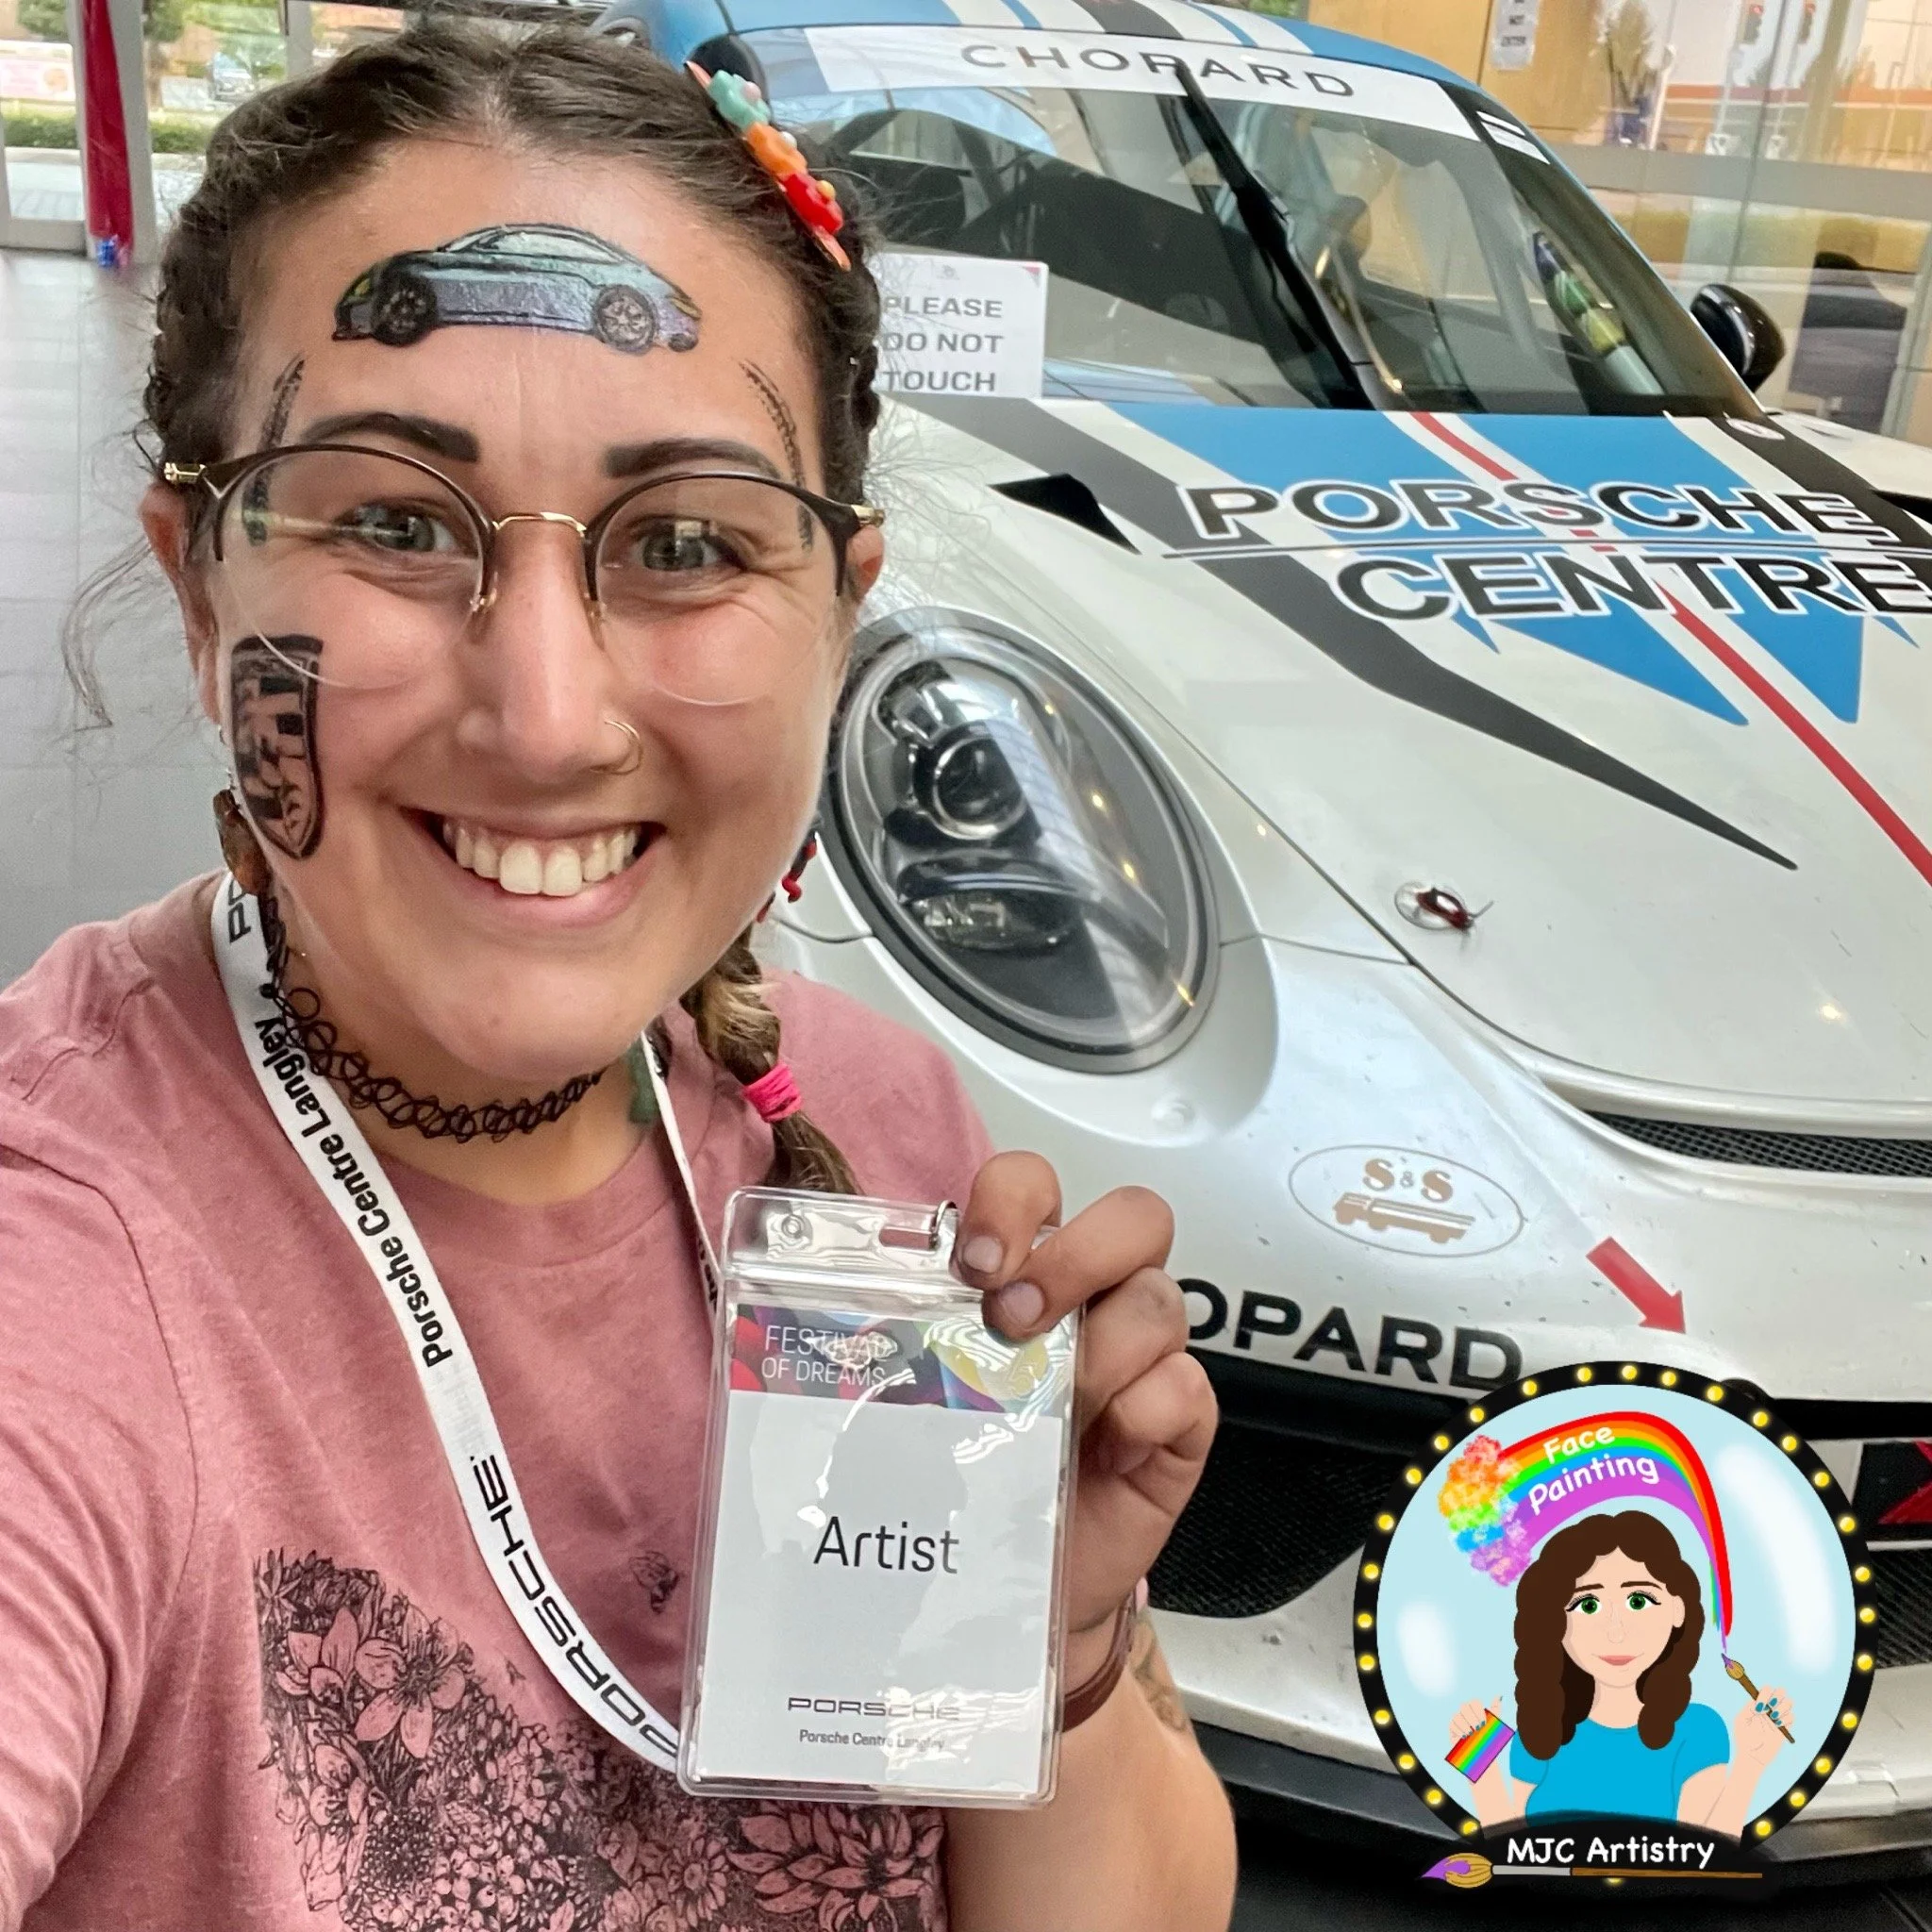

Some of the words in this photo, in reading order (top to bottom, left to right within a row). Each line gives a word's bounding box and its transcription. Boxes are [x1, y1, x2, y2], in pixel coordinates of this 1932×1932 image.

[960, 43, 1355, 97] CHOPARD
[883, 295, 1003, 319] PLEASE
[883, 331, 927, 353] DO
[937, 332, 1005, 354] NOT
[881, 370, 996, 392] TOUCH
[1178, 478, 1901, 545] PORSCHE
[1332, 552, 1932, 620] CENTRE
[254, 1017, 331, 1138] Langley
[320, 1134, 391, 1238] Centre
[380, 1236, 453, 1368] Porsche
[760, 1357, 791, 1379] OF
[795, 1359, 888, 1388] DREAMS
[813, 1515, 960, 1574] Artist
[473, 1454, 678, 1757] PORSCHE
[787, 1696, 960, 1722] PORSCHE
[799, 1728, 850, 1745] Porsche
